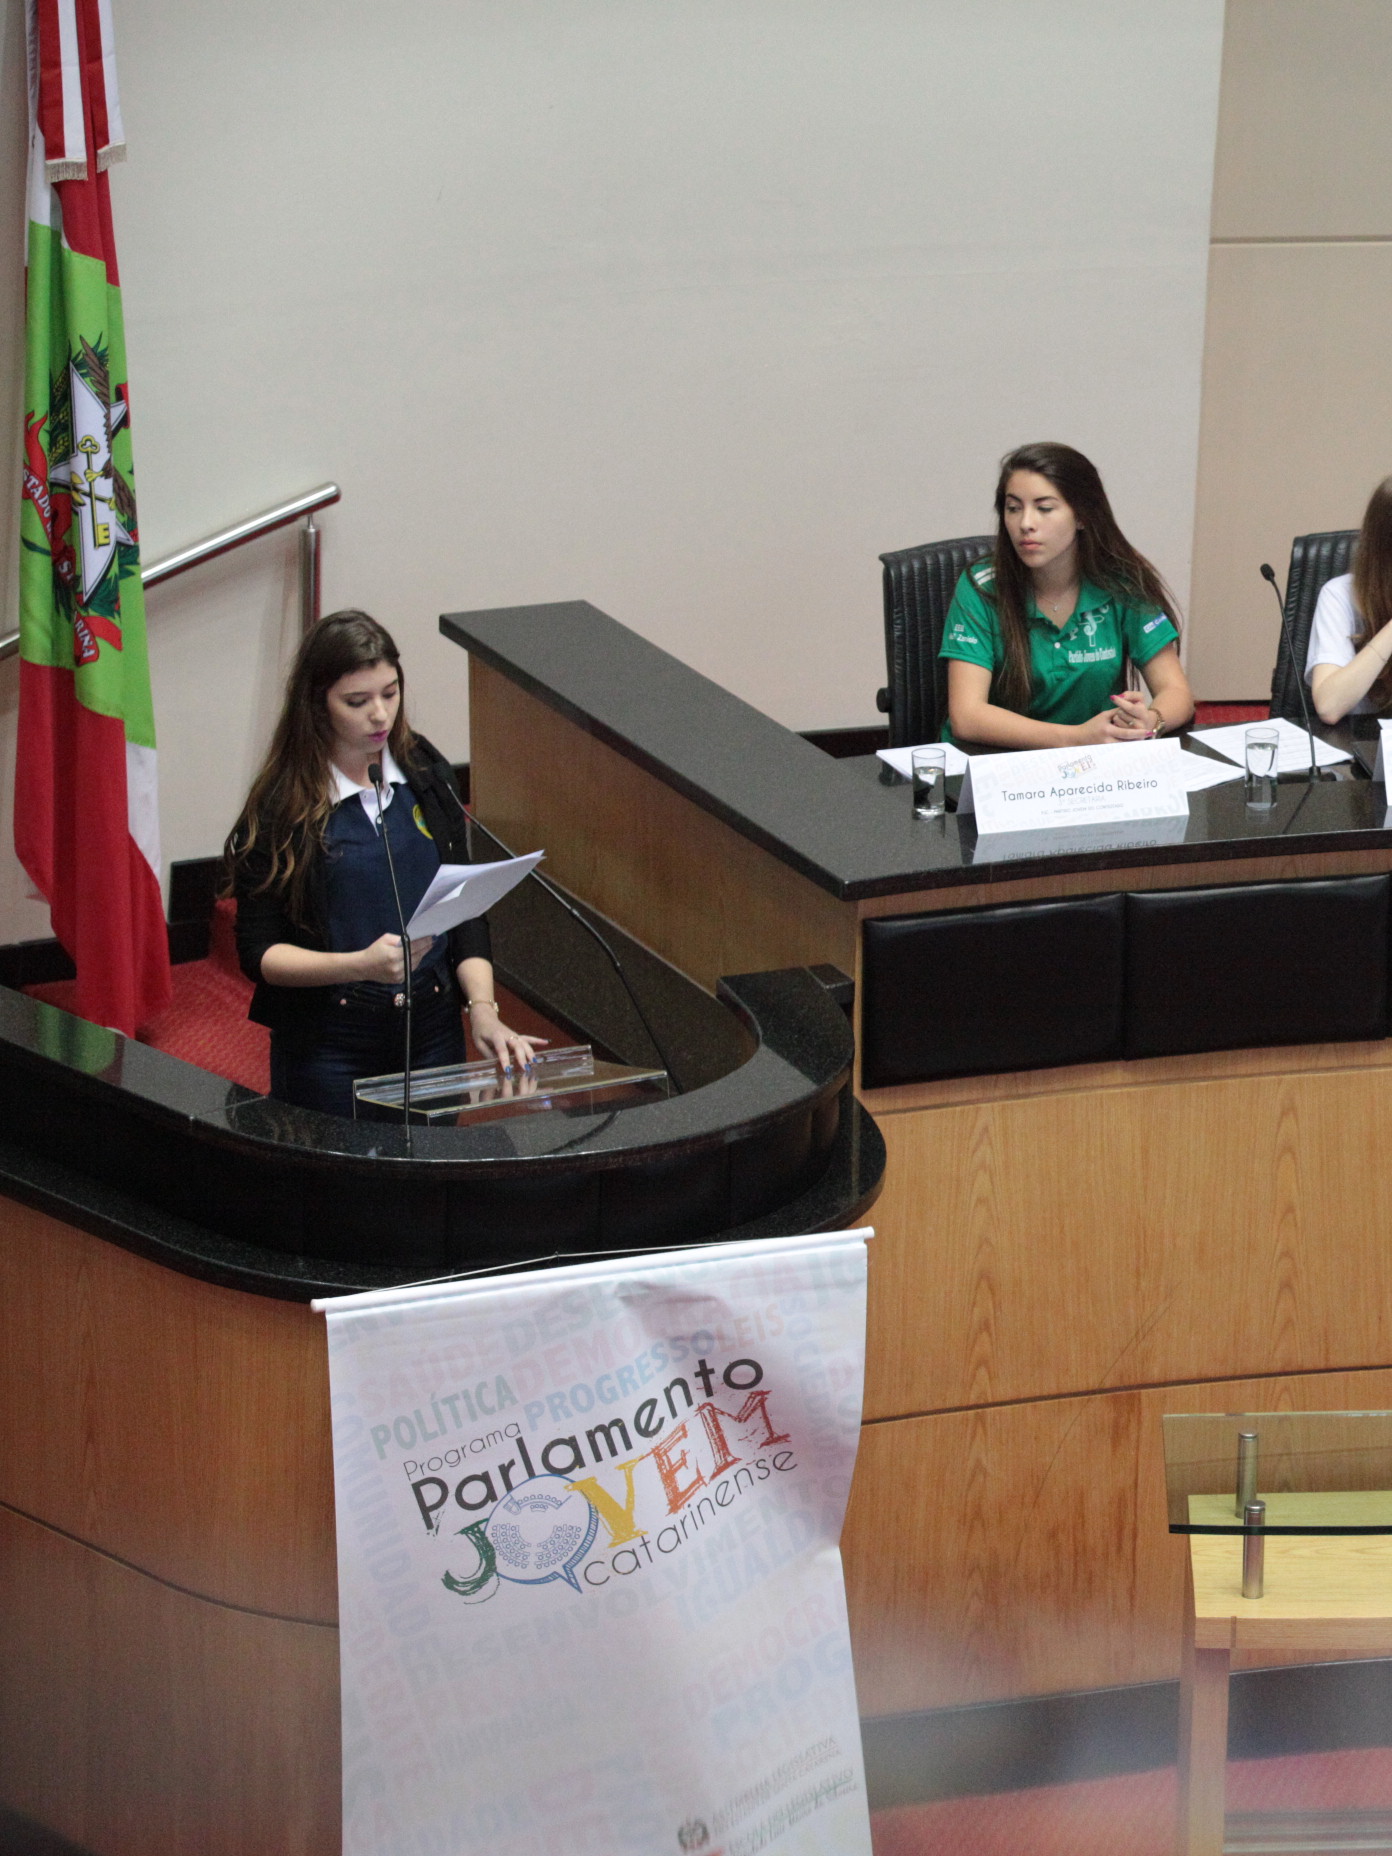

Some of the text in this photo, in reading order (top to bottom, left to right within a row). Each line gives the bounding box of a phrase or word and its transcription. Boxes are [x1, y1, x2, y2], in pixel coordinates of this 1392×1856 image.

[1002, 778, 1158, 802] Tamara Aparecida Ribeiro
[370, 1374, 519, 1461] POLÍTICA
[523, 1302, 785, 1433] PROGRESSO LEIS
[403, 1421, 522, 1481] Programa
[410, 1358, 763, 1530] Parlamento
[583, 1451, 798, 1586] catarinense
